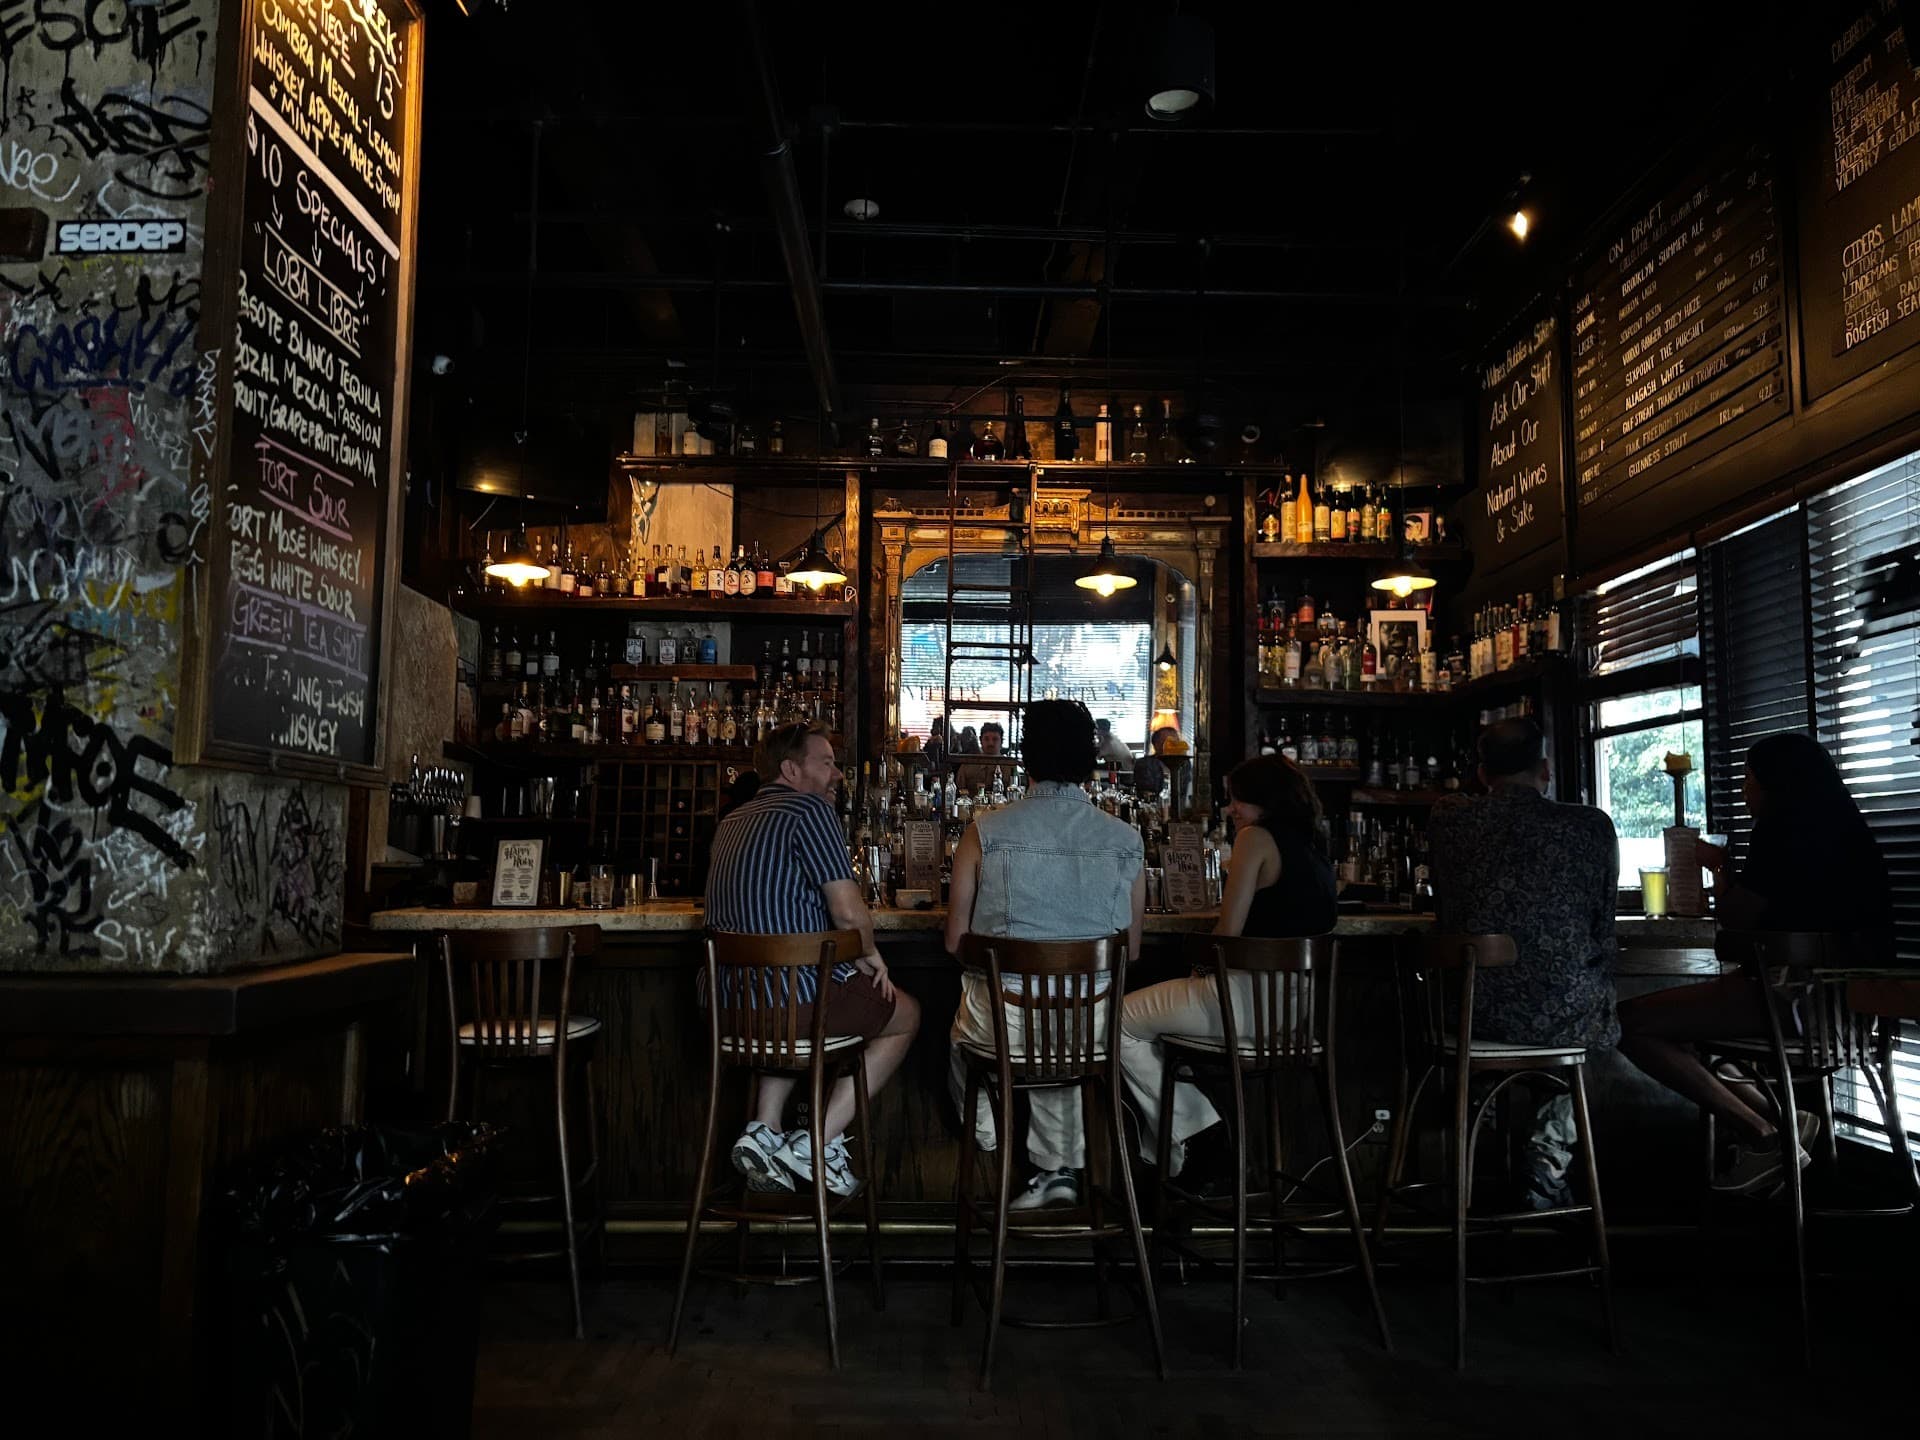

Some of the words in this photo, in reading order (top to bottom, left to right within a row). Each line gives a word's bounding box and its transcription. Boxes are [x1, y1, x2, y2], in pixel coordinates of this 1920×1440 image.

[358, 0, 403, 65] EEK:
[253, 23, 305, 107] WHISKEY
[246, 112, 284, 188] $10
[280, 93, 325, 157] MINT
[1608, 237, 1624, 264] ON
[1631, 200, 1664, 246] DRAFT
[1621, 259, 1655, 298] BROOKLYN
[1657, 232, 1689, 267] SUMMER
[1691, 216, 1706, 240] ALE
[1683, 294, 1702, 320] HAZE
[1842, 253, 1901, 302] LINDEMANS
[1625, 354, 1656, 388] SIXPOINT
[1659, 341, 1674, 363] THE
[1674, 318, 1706, 351] PURSUIT
[1845, 309, 1890, 350] DOGFISH
[287, 319, 334, 381] BLANCO
[337, 357, 382, 419] TEQUILA
[1625, 379, 1657, 412] ALLAGASH
[1660, 358, 1686, 387] WHITE
[336, 391, 382, 449] PASSION
[1490, 392, 1510, 432] Ask
[1511, 380, 1530, 412] Our
[1490, 430, 1517, 471] About
[1520, 418, 1540, 447] Our
[1628, 448, 1661, 479] GUINNESS
[1663, 431, 1688, 457] STOUT
[227, 484, 267, 545] ORT
[308, 472, 350, 529] SOUR
[1486, 474, 1517, 518] Natural
[1518, 462, 1548, 495] Wines
[1496, 517, 1506, 544] &
[1510, 499, 1536, 534] Sake
[270, 557, 314, 601] WHITE
[317, 573, 357, 623] SOUR
[303, 613, 329, 659] TEA
[332, 624, 365, 677] SHOT
